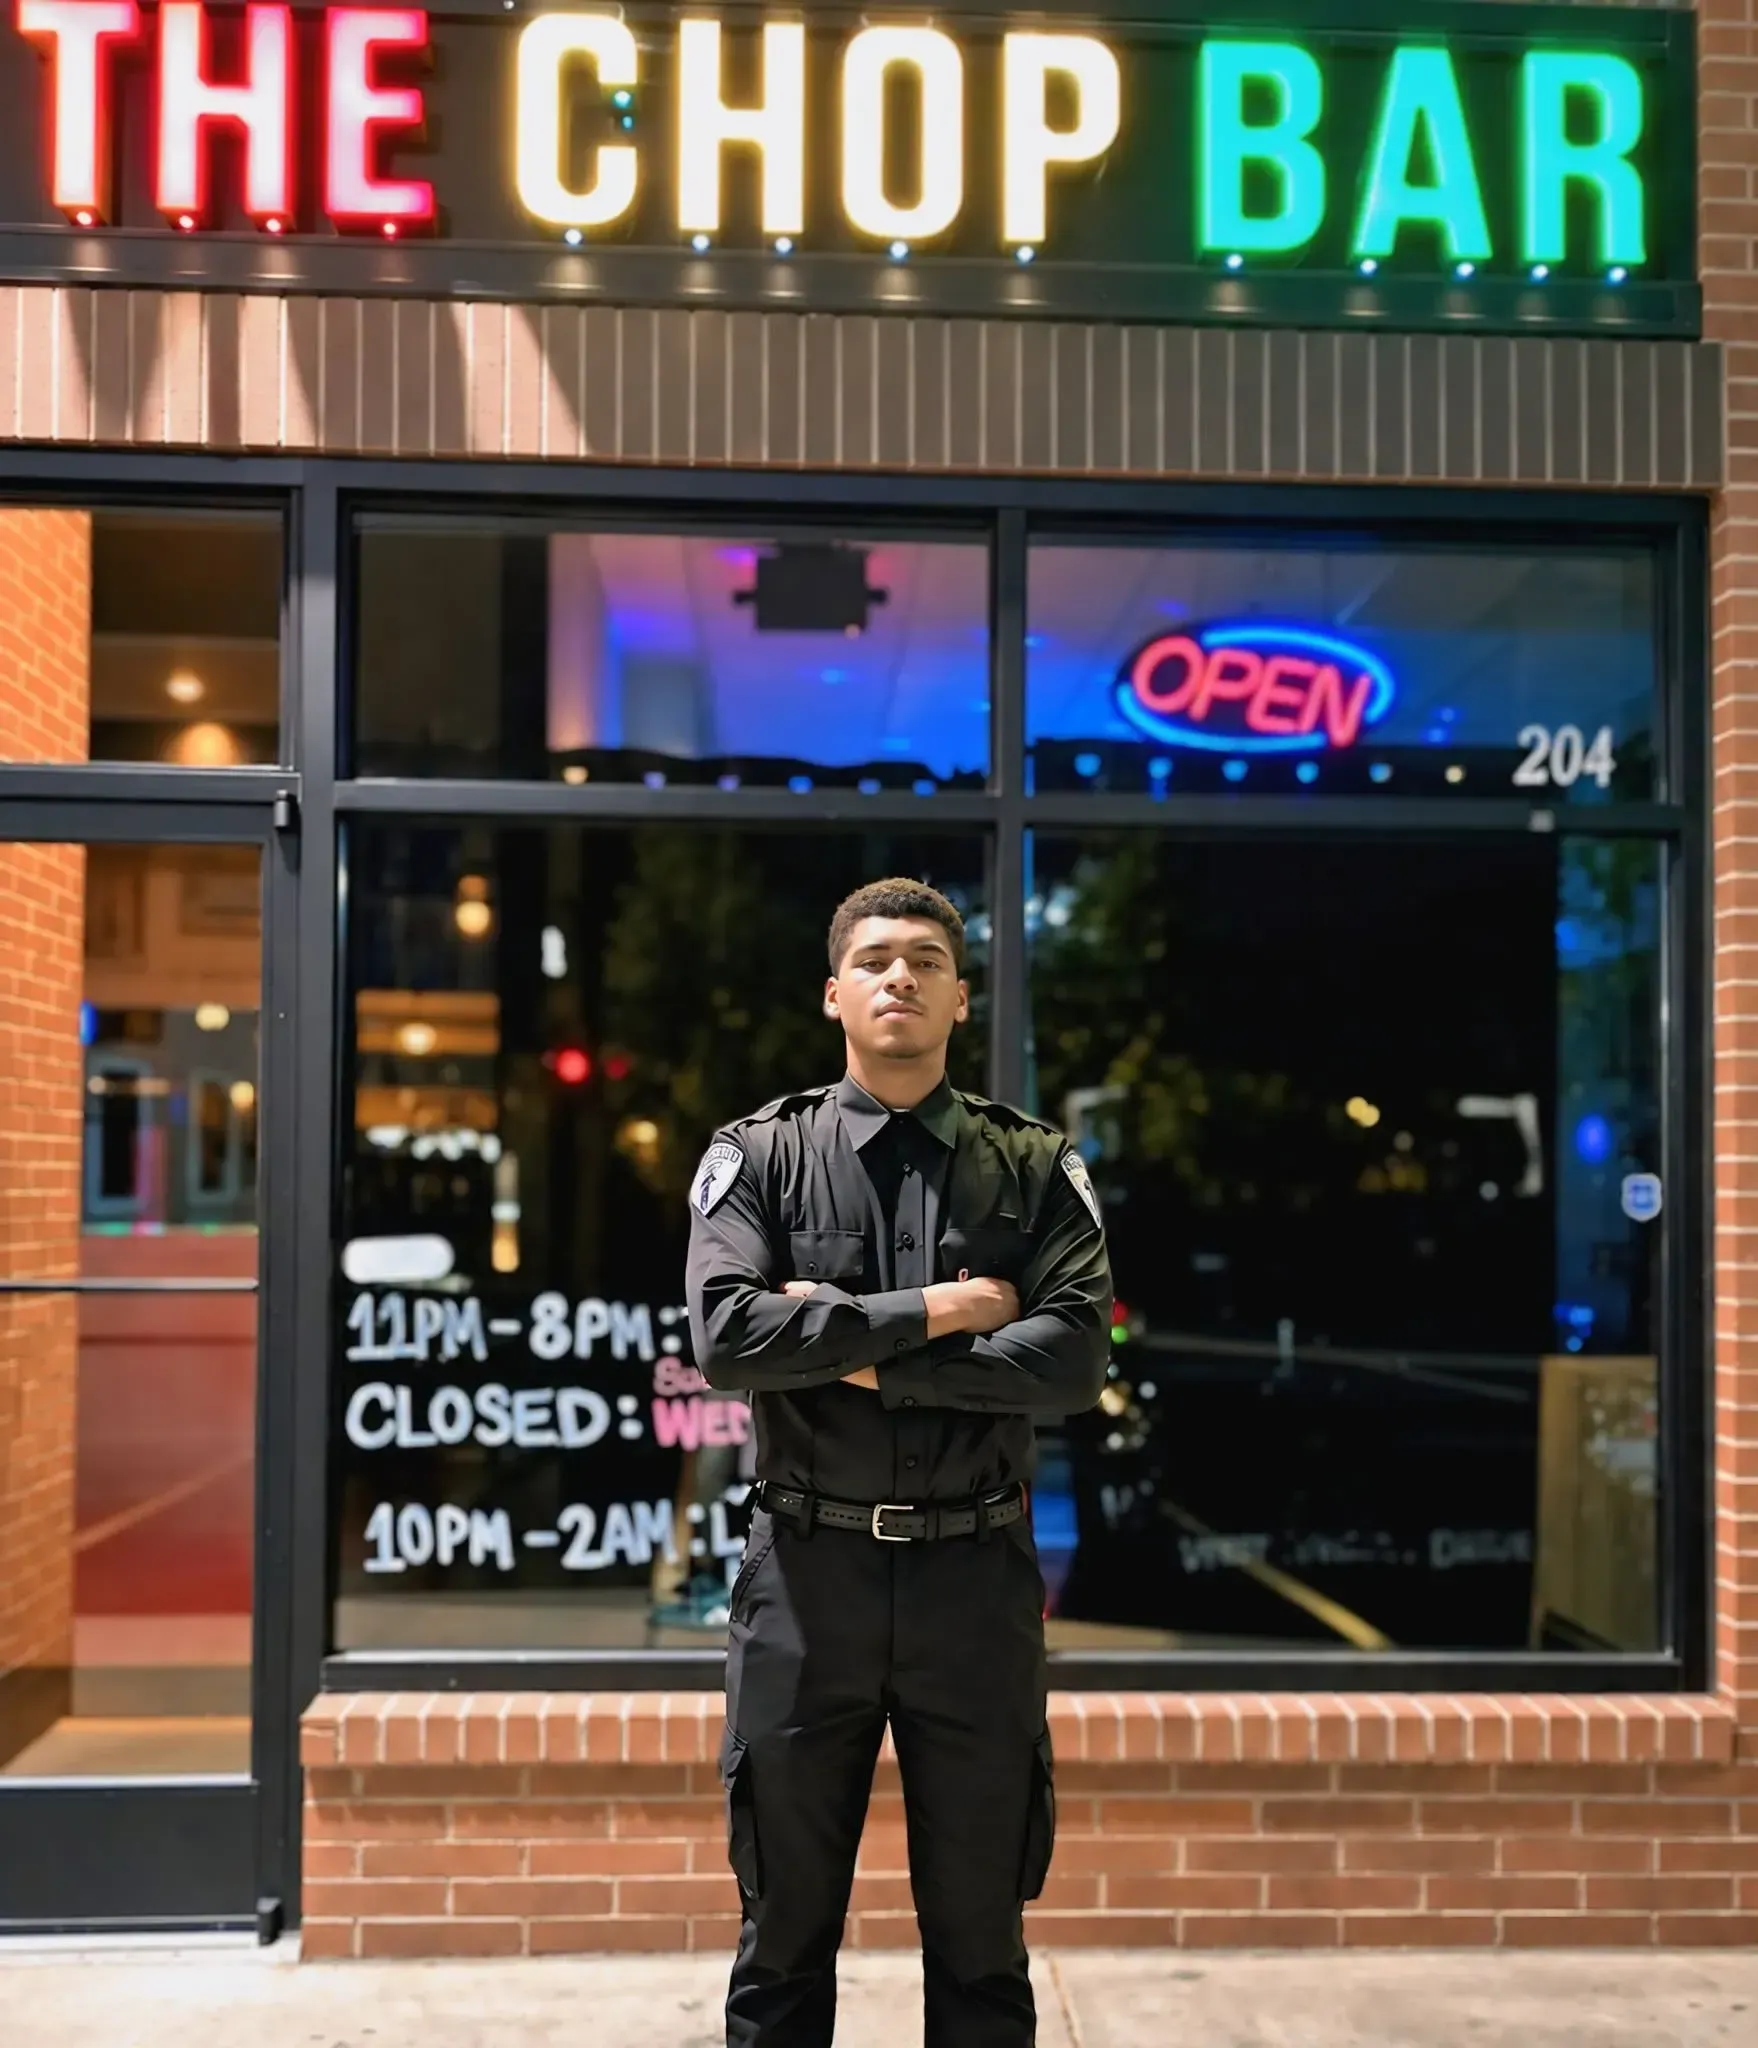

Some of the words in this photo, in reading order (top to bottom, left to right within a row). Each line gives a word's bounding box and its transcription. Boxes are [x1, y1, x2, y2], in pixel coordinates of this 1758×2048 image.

[16, 0, 434, 221] THE
[514, 12, 1122, 246] CHOP
[1199, 39, 1647, 266] BAR
[1132, 634, 1373, 748] OPEN
[1511, 723, 1617, 789] 204
